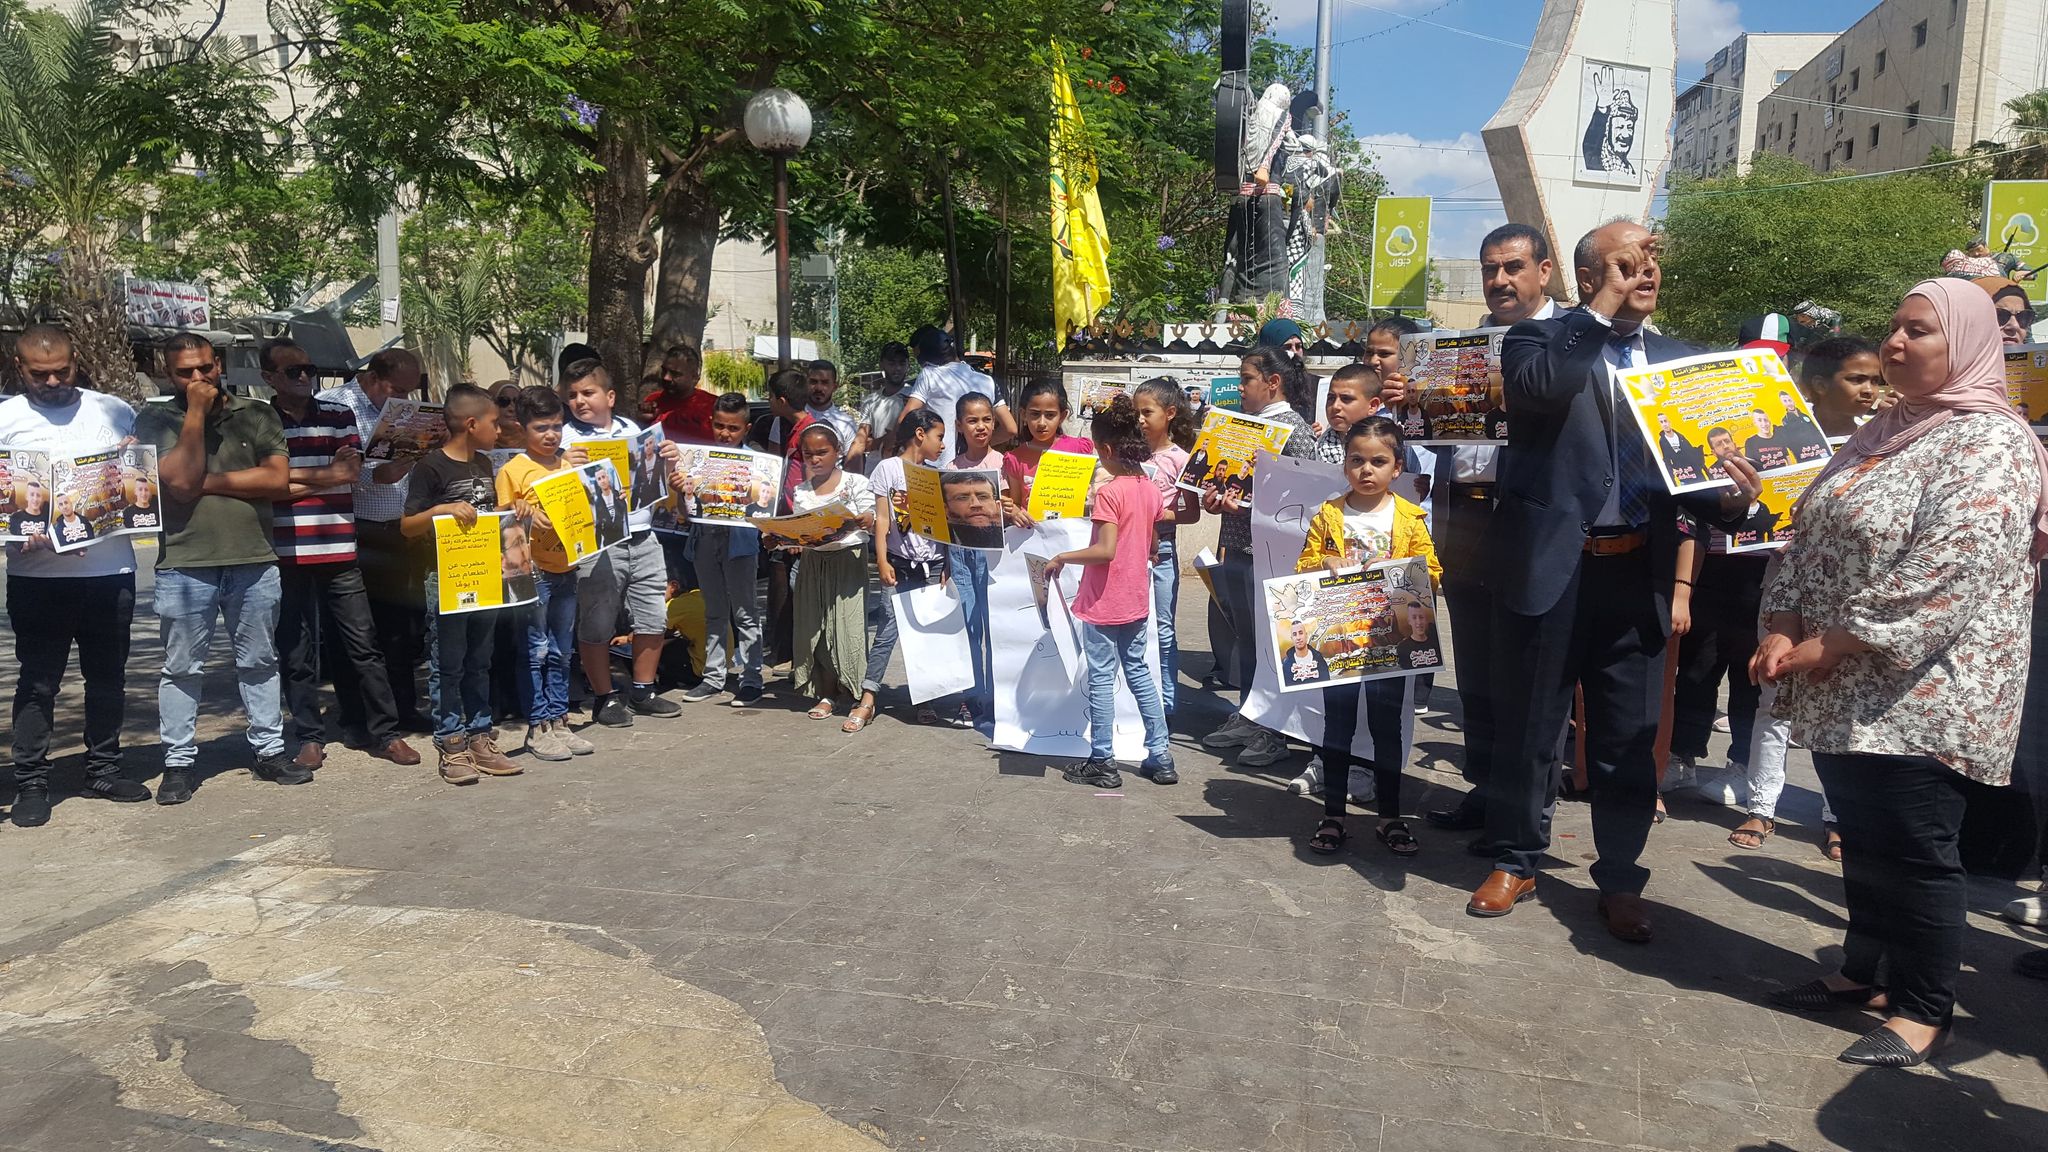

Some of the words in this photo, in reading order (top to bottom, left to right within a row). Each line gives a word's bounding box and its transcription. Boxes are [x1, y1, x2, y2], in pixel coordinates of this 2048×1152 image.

[1673, 365, 1700, 376] كرامتنا
[1701, 363, 1717, 371] عنوان
[1215, 383, 1239, 397] طني
[447, 562, 458, 570] عن
[461, 561, 486, 569] مضرب
[447, 571, 461, 579] منذ
[462, 569, 489, 580] الطعام
[1365, 570, 1382, 580] اسرانا
[1321, 577, 1345, 587] كرامتنا
[1347, 575, 1362, 584] عنوان
